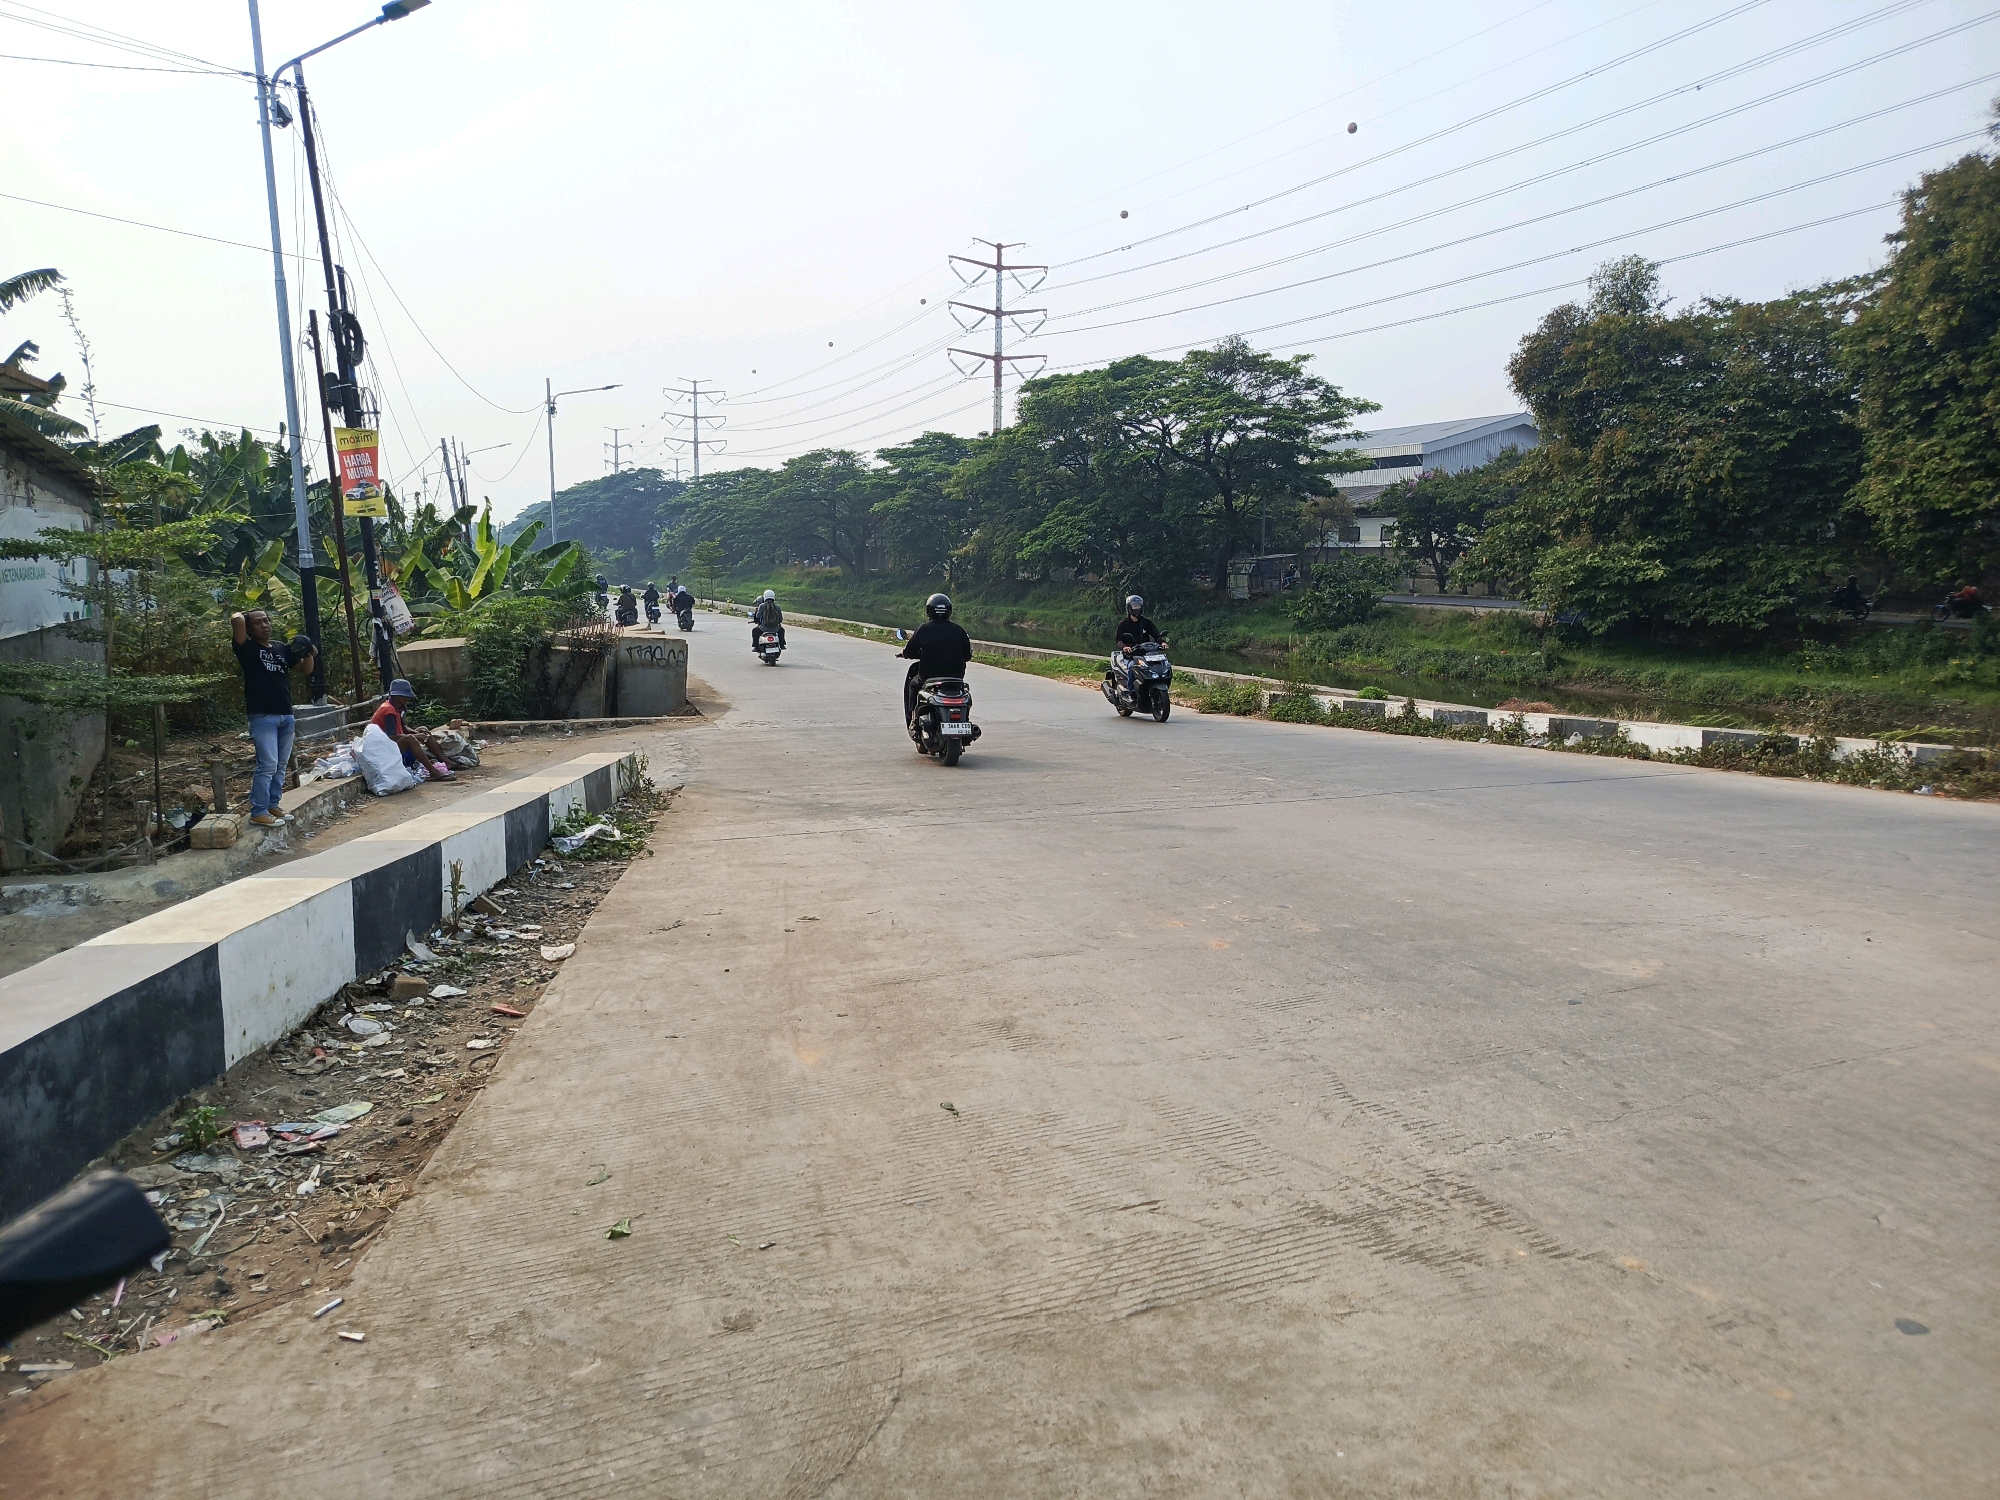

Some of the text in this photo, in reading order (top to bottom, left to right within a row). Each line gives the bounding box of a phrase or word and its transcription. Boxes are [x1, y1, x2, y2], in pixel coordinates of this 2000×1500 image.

[339, 433, 373, 446] maxim
[342, 452, 372, 468] HARGA
[345, 465, 375, 480] MURAH
